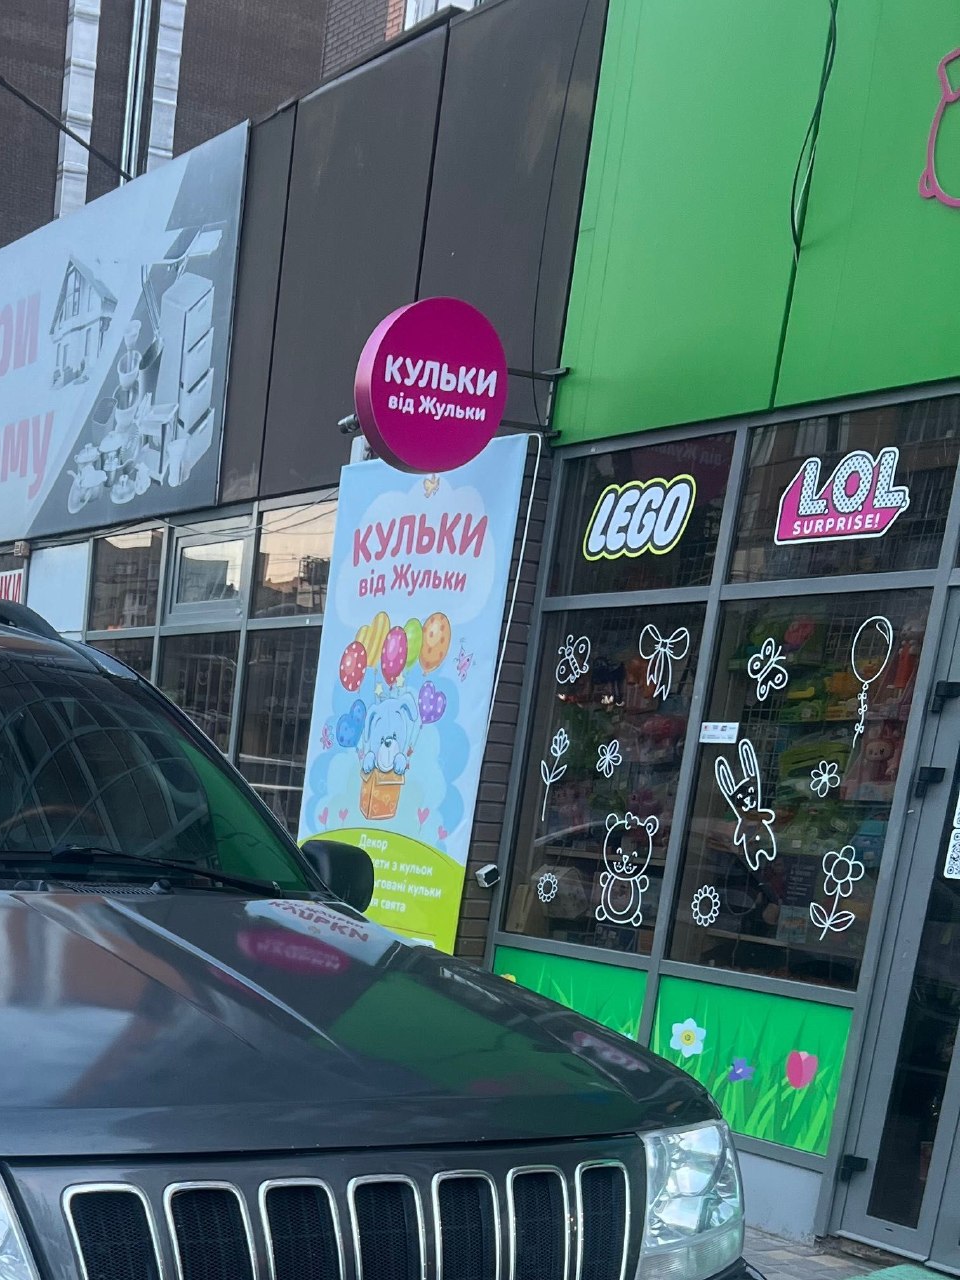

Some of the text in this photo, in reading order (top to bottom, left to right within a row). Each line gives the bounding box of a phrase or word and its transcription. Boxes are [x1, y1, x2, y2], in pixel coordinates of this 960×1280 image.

[384, 354, 498, 398] КУЛЬКИ
[388, 392, 486, 421] від Жульки
[587, 481, 692, 555] LEGO
[792, 512, 881, 536] SURPRISE!
[353, 512, 488, 567] КУЛЬКИ
[358, 563, 467, 597] від Жульки
[358, 833, 388, 852] Декор
[373, 858, 433, 876] ети з кульок
[408, 885, 442, 898] кульки
[380, 898, 406, 913] свята
